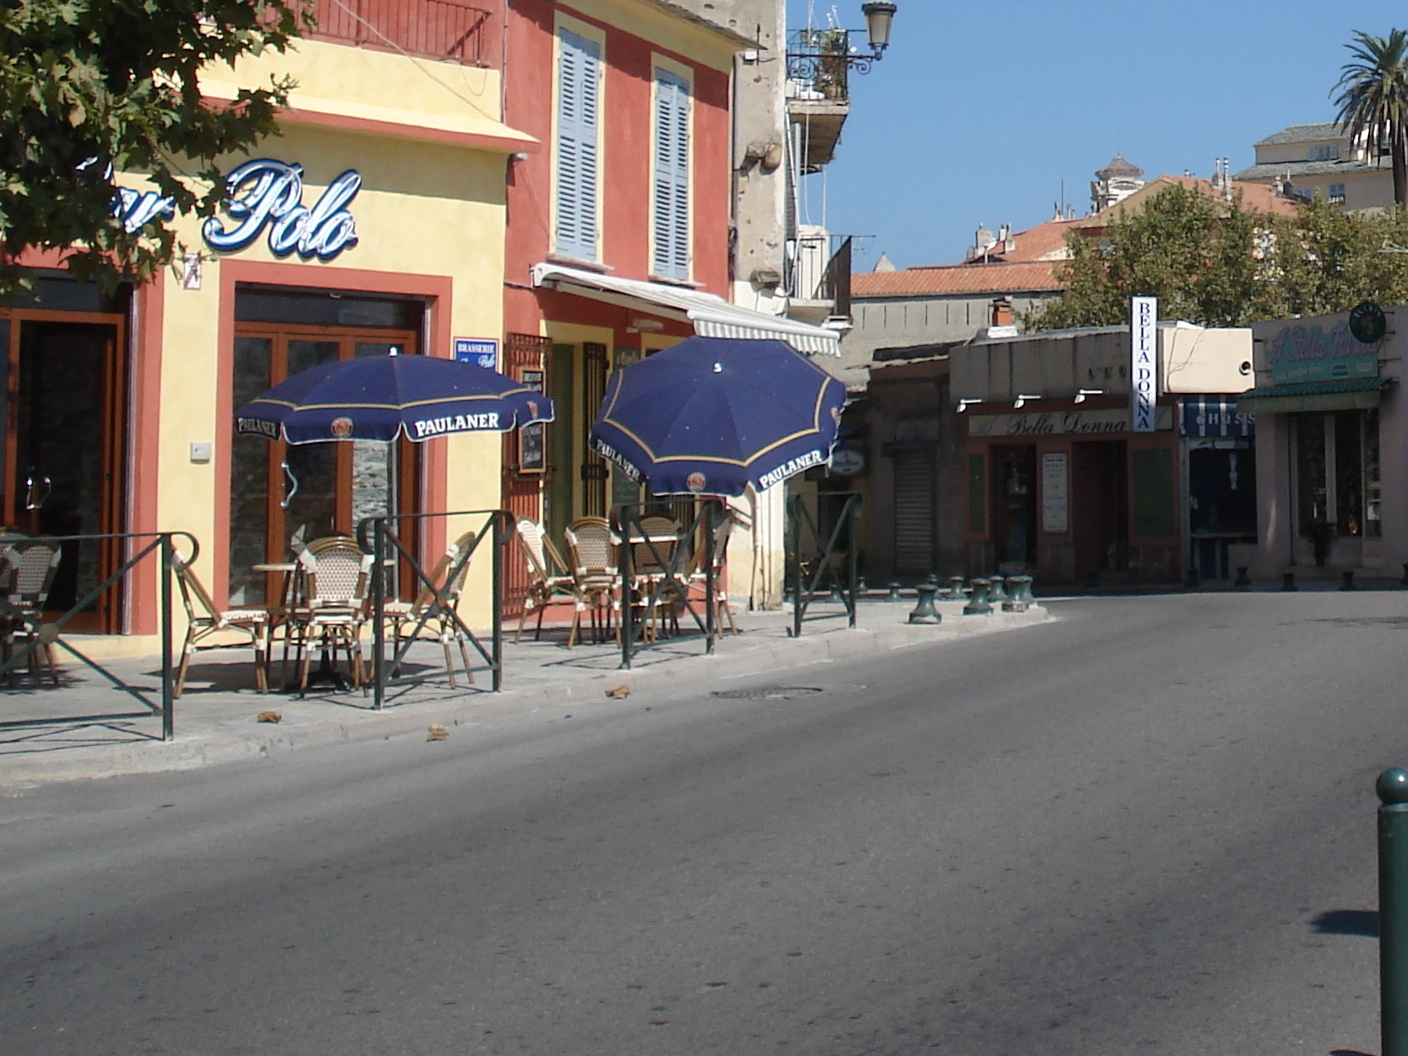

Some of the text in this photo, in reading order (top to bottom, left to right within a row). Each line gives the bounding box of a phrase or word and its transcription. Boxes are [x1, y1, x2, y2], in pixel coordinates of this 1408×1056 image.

[202, 157, 362, 261] Polo
[457, 343, 495, 354] BRASSERIE
[1137, 302, 1151, 429] BELLA DONNA
[238, 416, 277, 439] PAULANER
[414, 411, 499, 438] PAULANER
[1007, 412, 1126, 435] Bella Donna
[596, 438, 641, 482] PAULANER
[759, 449, 823, 490] PAULANER
